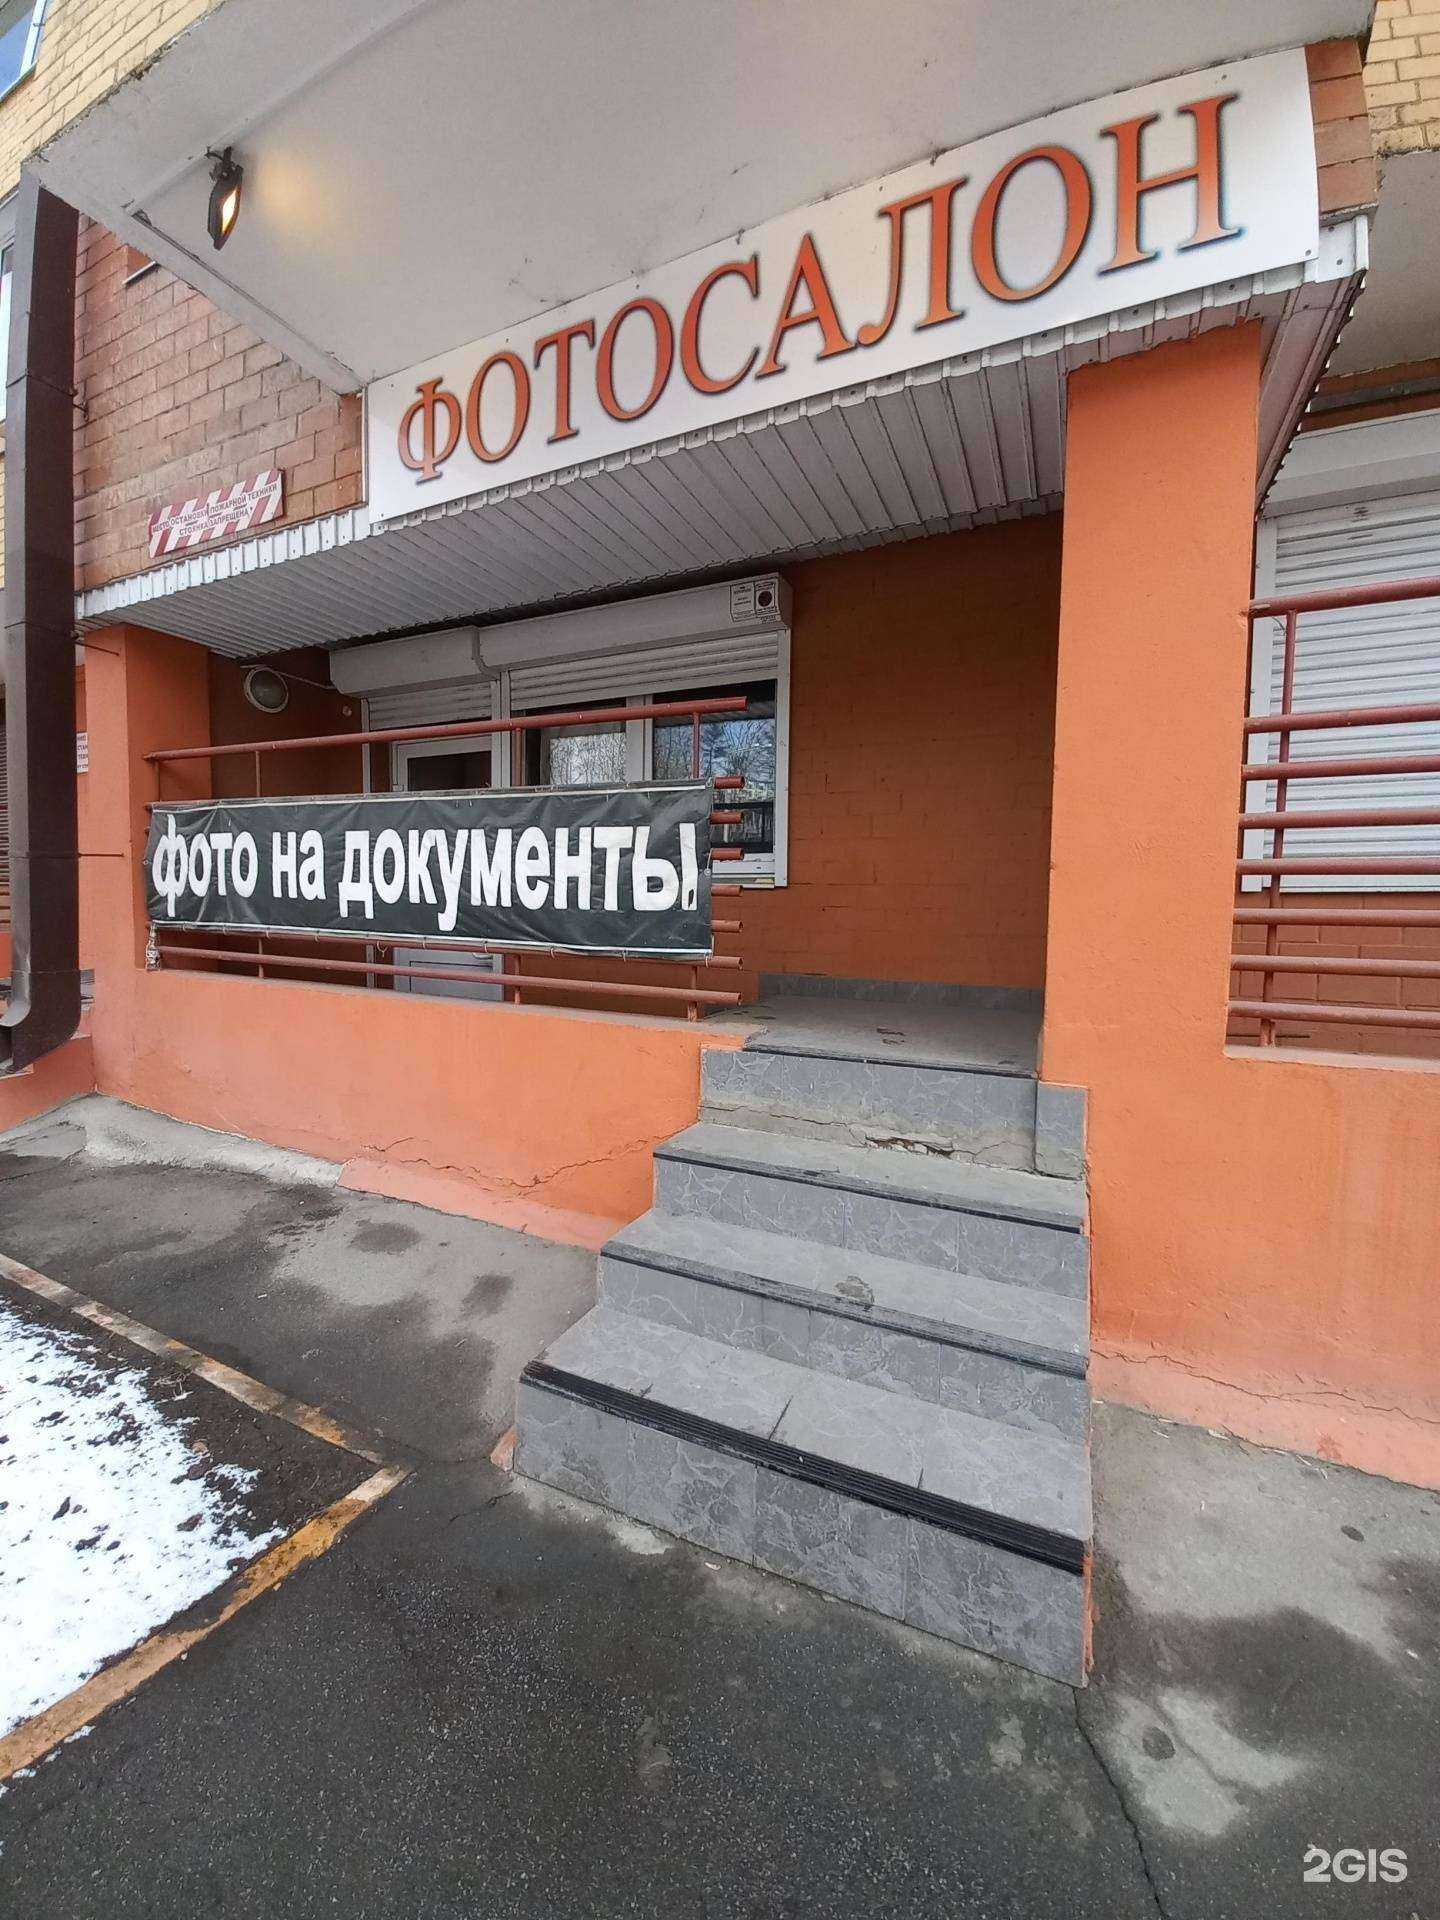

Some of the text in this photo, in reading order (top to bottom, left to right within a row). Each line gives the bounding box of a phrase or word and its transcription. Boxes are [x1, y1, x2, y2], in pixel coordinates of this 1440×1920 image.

[398, 92, 1243, 485] ФОТОСАЛОН
[208, 508, 249, 527] ЗАПРЕЩЕНА
[210, 493, 247, 514] ПОЖАРНОЙ
[248, 483, 278, 501] ТЕХНИКИ
[152, 814, 699, 931] фото на документы
